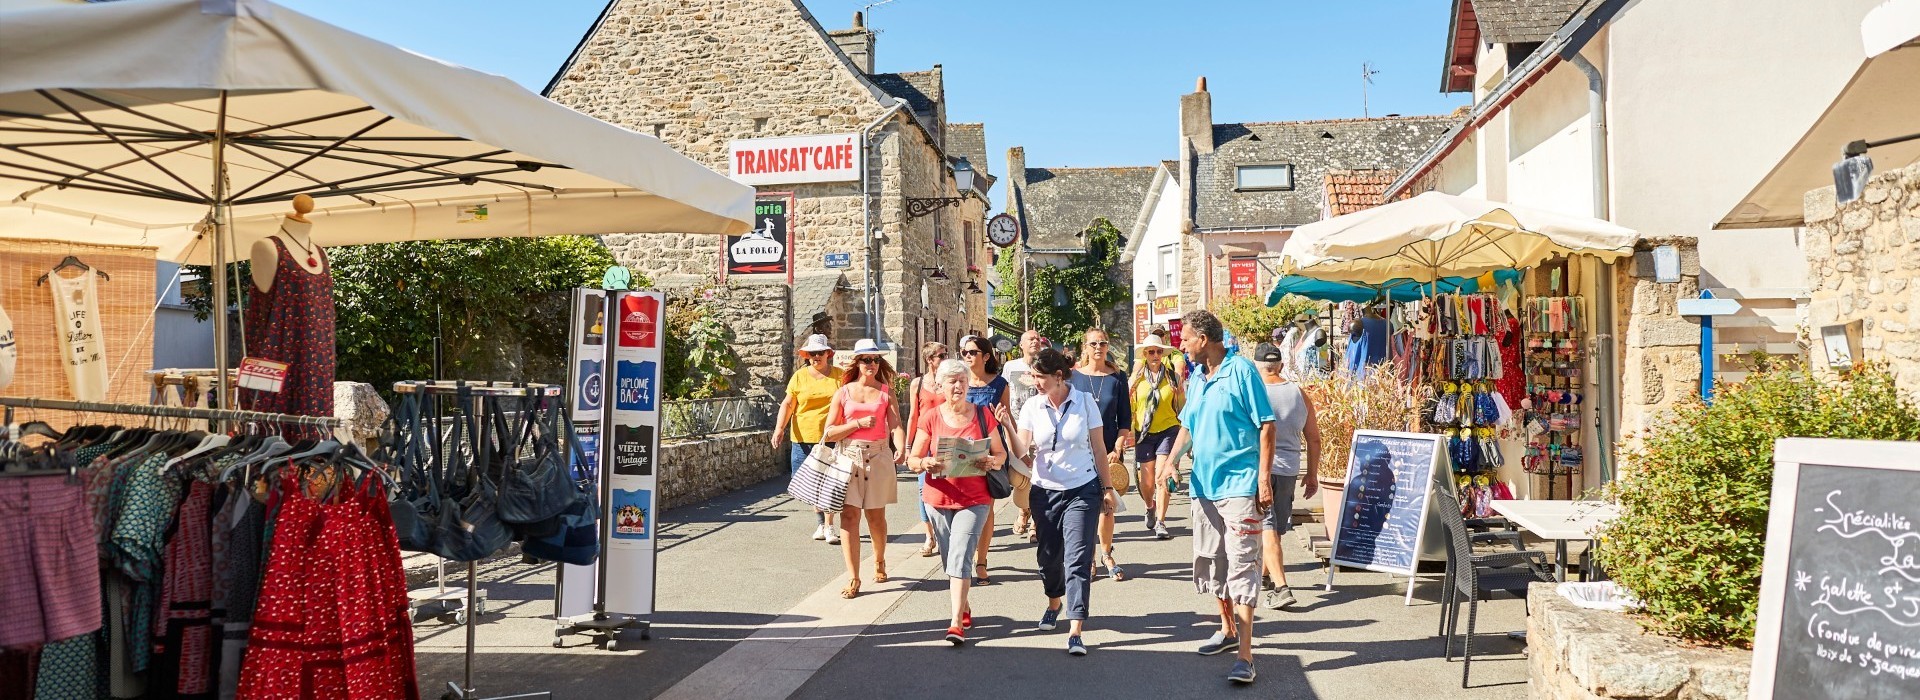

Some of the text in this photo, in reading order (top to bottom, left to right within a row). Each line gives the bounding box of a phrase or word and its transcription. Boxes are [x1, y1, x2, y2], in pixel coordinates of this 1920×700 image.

[736, 137, 853, 174] TRANSAT'CAFÉ
[736, 246, 779, 255] LA FORGE
[70, 311, 86, 320] LIFE
[618, 444, 647, 453] VIEUX
[616, 455, 648, 467] Vintage
[1819, 575, 1874, 605] Galette
[1866, 631, 1882, 651] de
[1839, 648, 1853, 663] de
